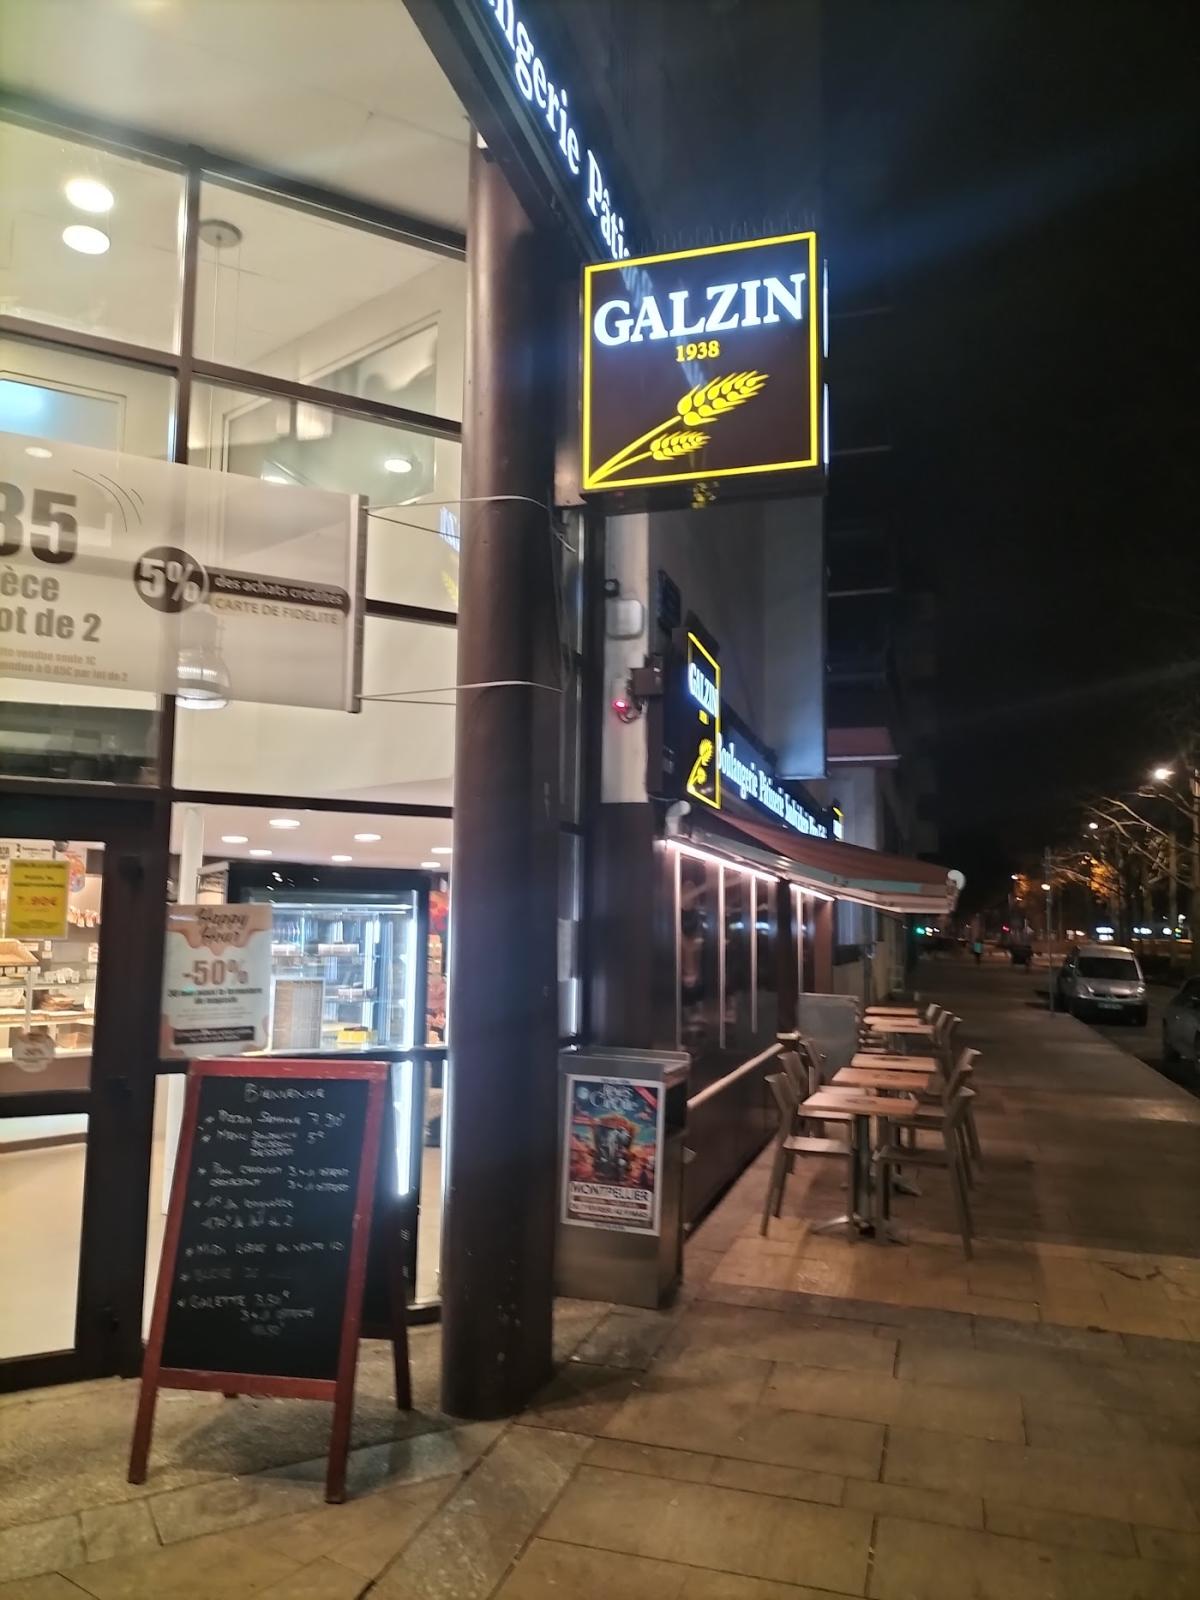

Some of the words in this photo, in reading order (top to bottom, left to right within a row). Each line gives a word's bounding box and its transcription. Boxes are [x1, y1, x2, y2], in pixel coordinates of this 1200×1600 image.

[487, 0, 580, 175] ngerie
[587, 149, 630, 259] Pâti
[593, 272, 806, 346] GALZIN
[675, 340, 720, 363] 1938
[138, 557, 200, 603] 5%
[34, 607, 75, 639] de
[81, 612, 102, 643] 2
[261, 604, 279, 617] DE
